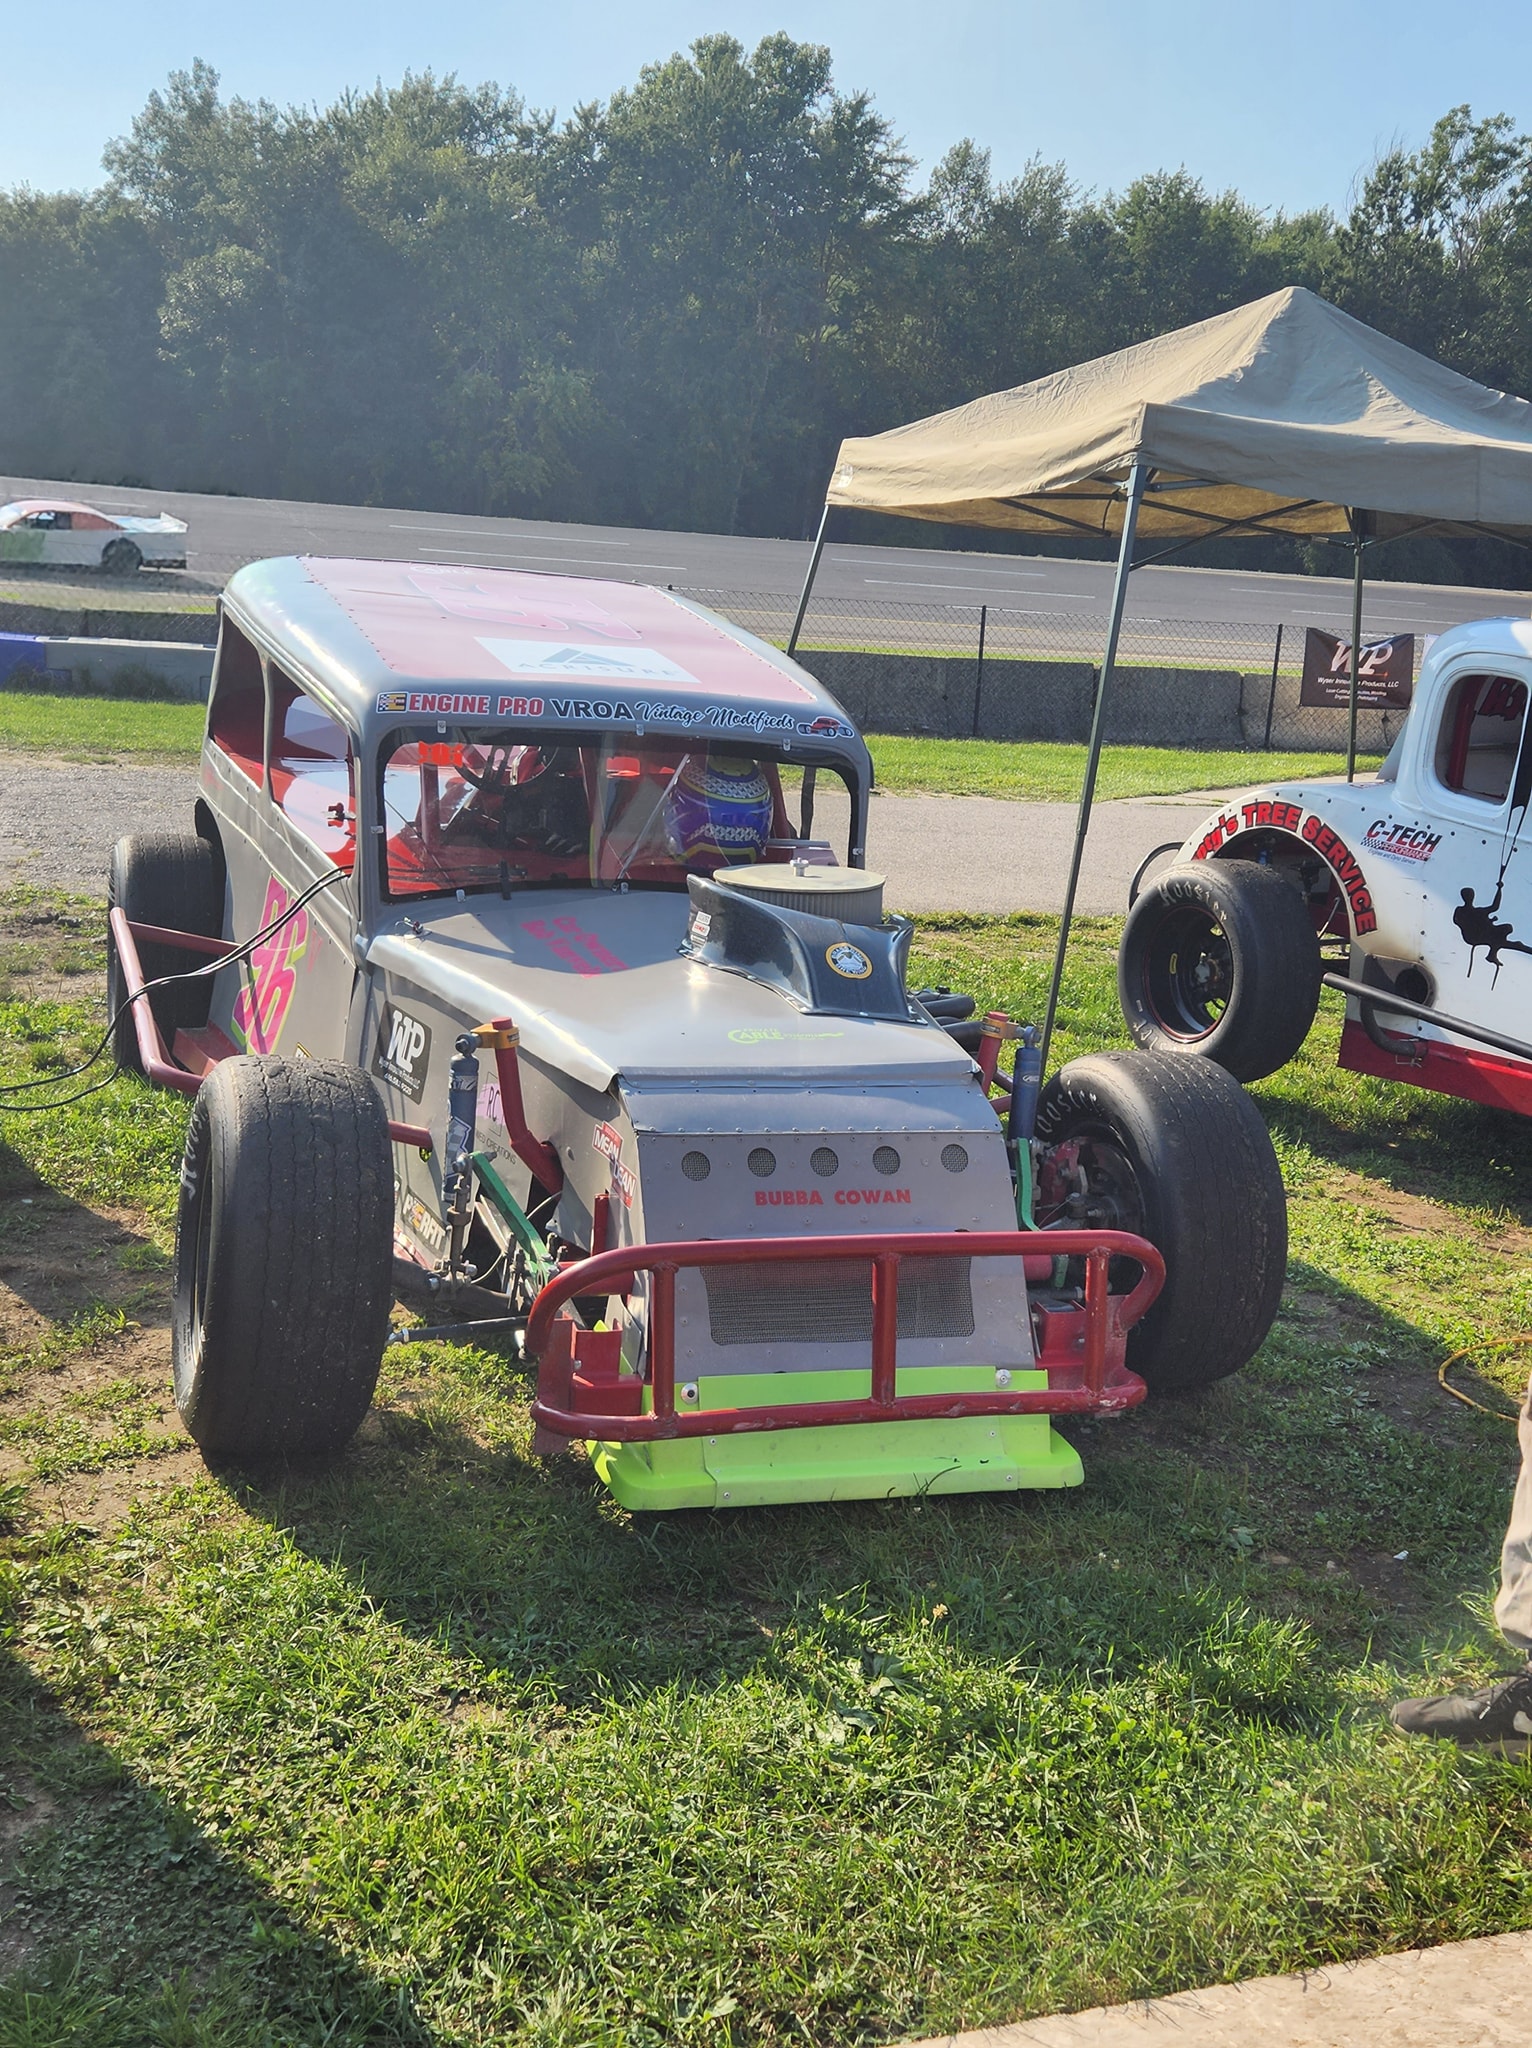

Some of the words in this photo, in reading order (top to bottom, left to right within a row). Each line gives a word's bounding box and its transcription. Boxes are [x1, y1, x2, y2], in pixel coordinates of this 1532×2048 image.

[408, 694, 489, 714] ENGINE
[498, 697, 543, 716] PRO
[551, 699, 634, 720] VROA
[635, 701, 704, 727] Vintage
[706, 706, 795, 733] Modifieds
[1366, 819, 1443, 853] C-TECH
[1242, 801, 1303, 832] TREE
[1302, 815, 1378, 936] SERVICE
[727, 1028, 784, 1045] CABLE
[594, 1129, 620, 1161] MEAN
[613, 1160, 636, 1198] DEAN
[754, 1190, 824, 1206] BUBBA
[833, 1189, 912, 1205] COWAN
